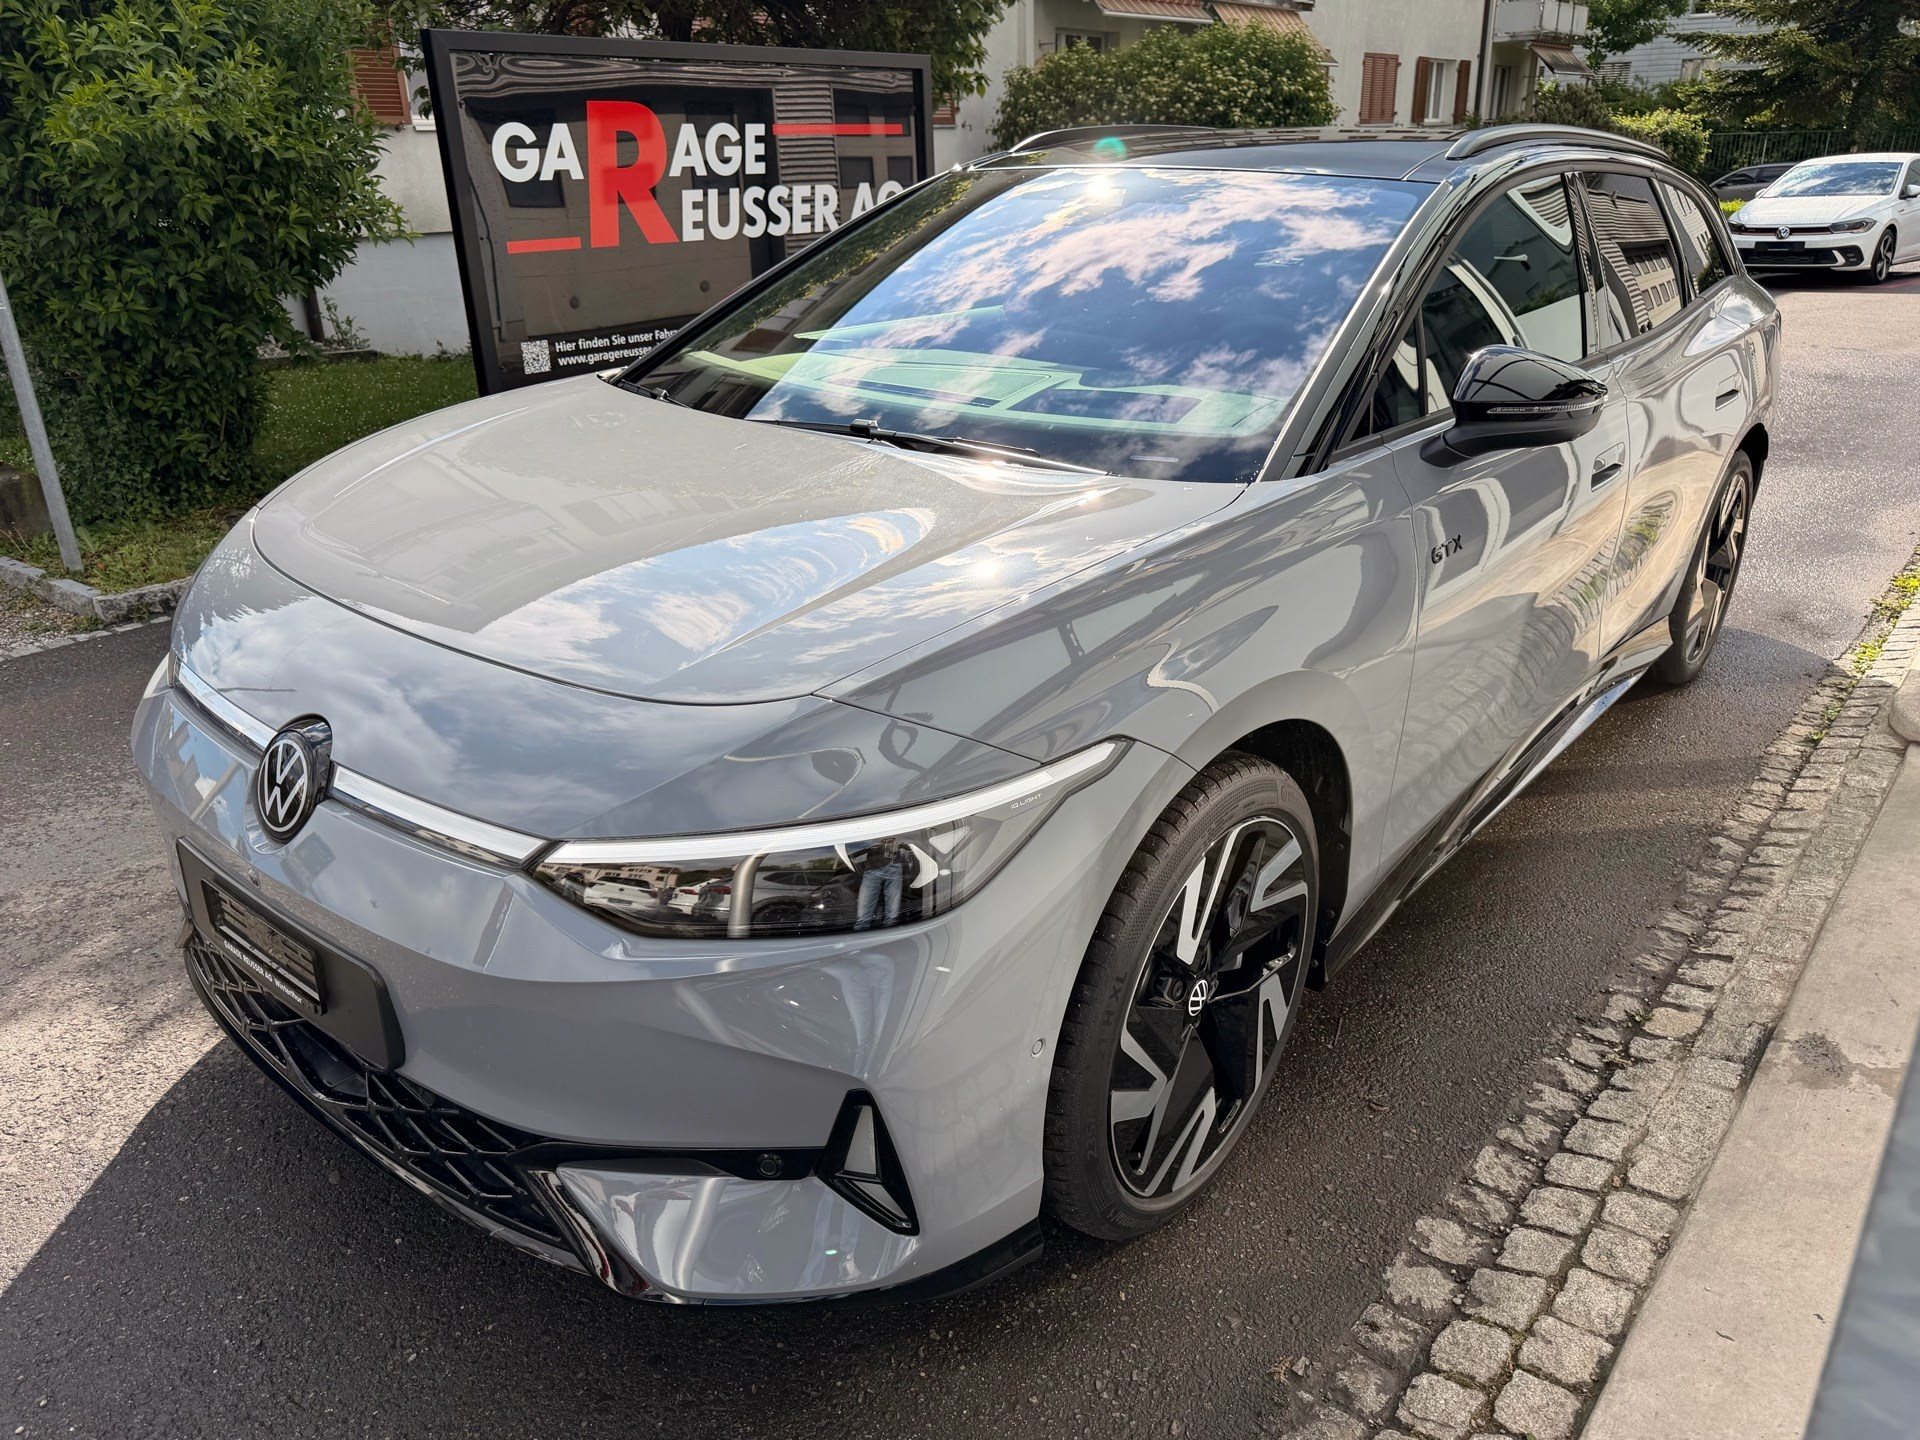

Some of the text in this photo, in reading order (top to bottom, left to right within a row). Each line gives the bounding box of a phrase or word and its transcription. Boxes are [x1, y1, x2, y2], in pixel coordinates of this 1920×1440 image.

[491, 100, 766, 248] GARAGE
[555, 340, 576, 352] Hier
[578, 336, 610, 350] finden
[611, 334, 626, 346] Sie
[627, 332, 653, 343] unser
[1431, 535, 1463, 564] GTX
